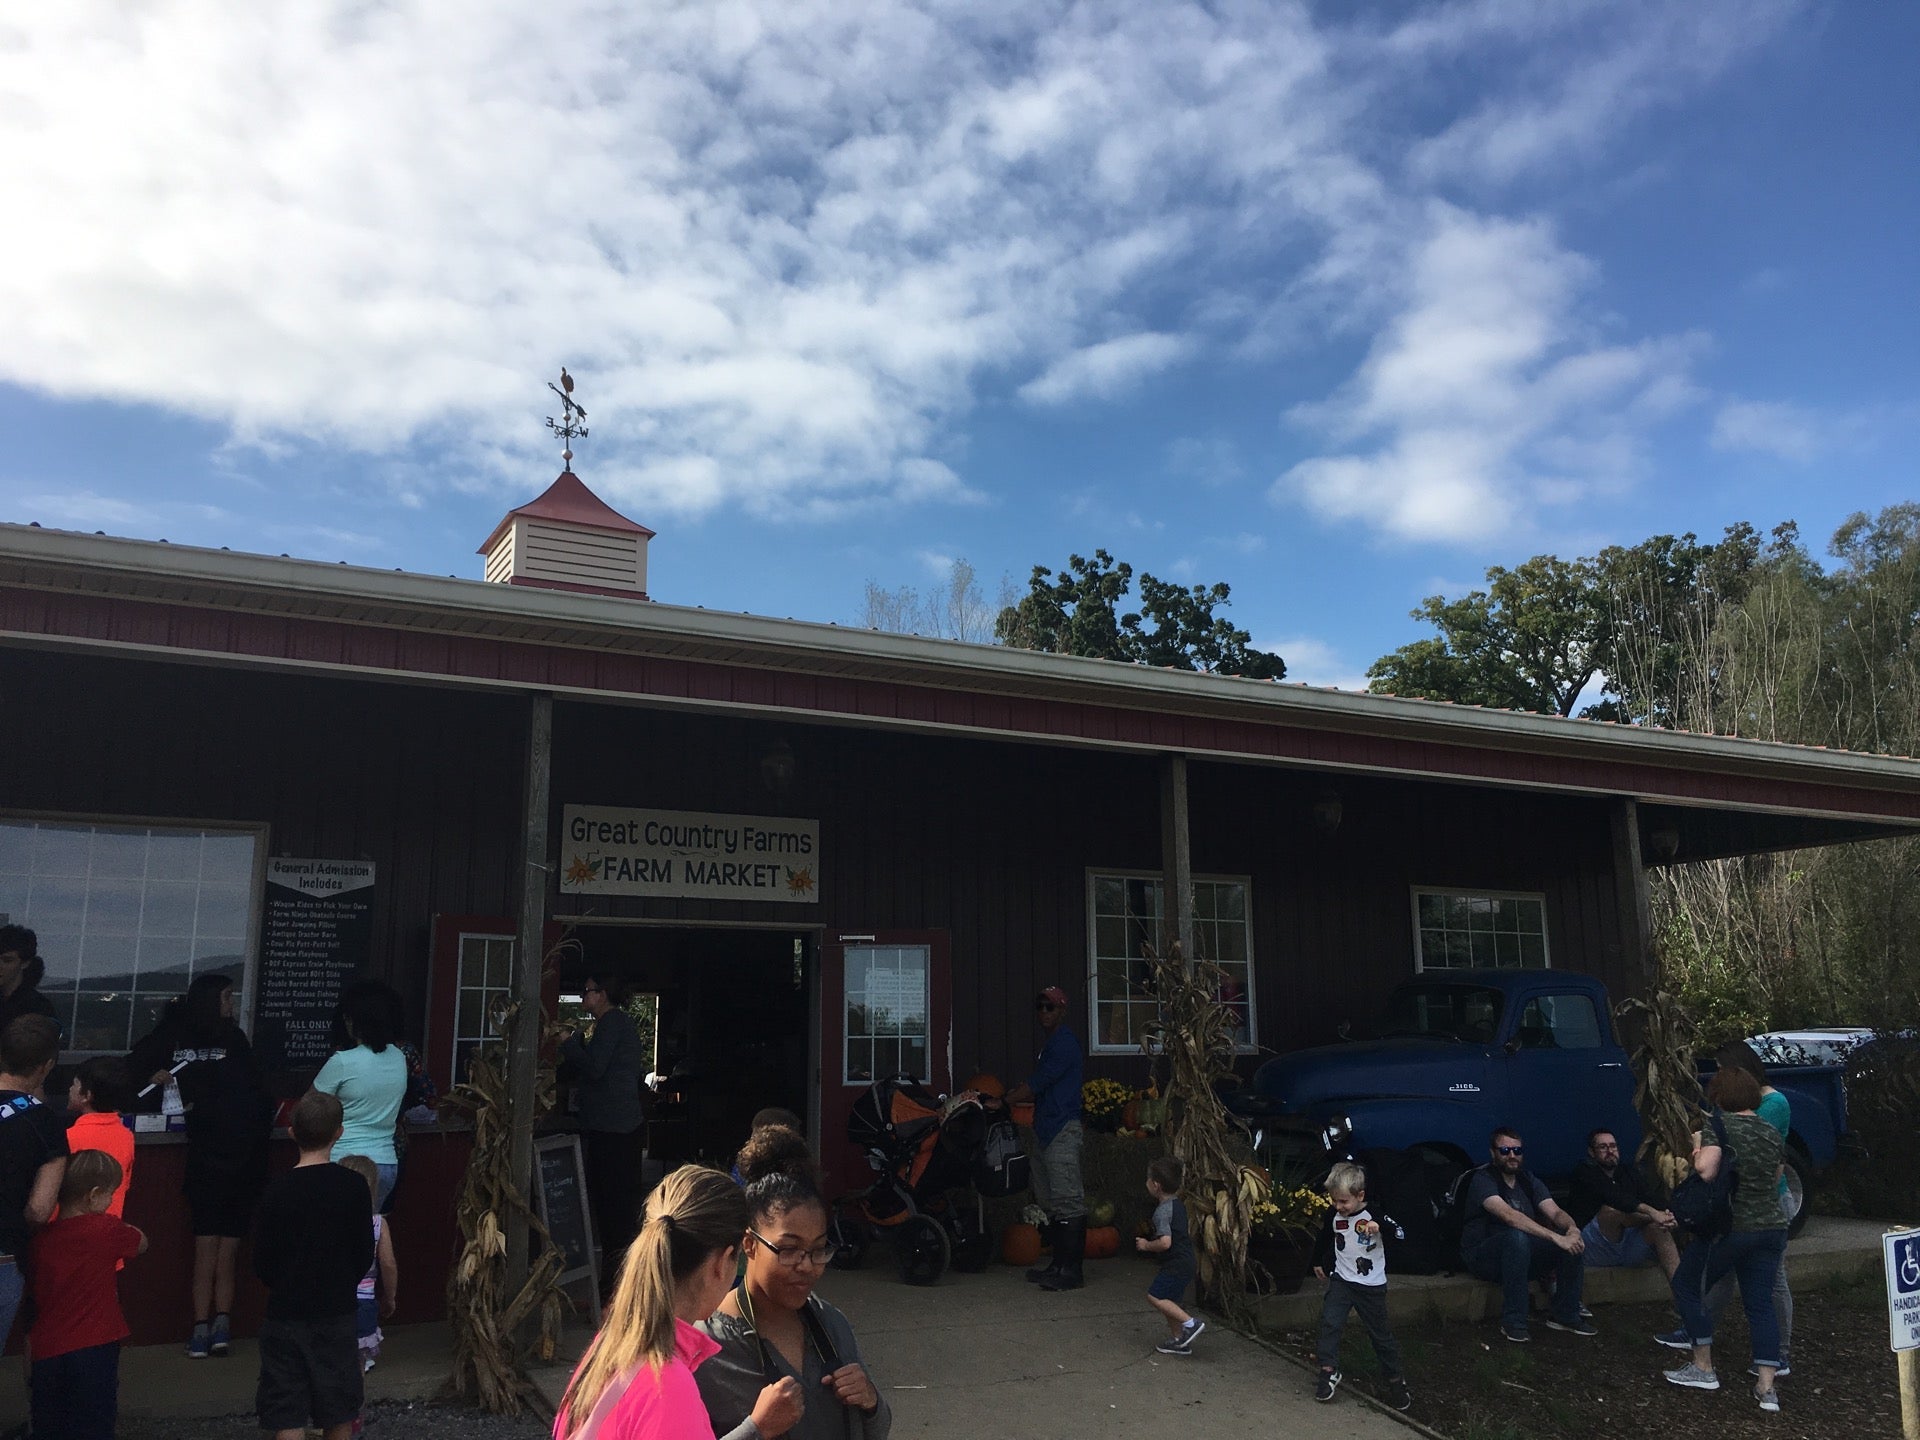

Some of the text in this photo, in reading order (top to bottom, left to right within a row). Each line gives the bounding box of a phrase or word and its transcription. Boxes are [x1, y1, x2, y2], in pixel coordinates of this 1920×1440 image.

[571, 816, 812, 854] Great Country Farms
[274, 861, 369, 876] General Admission
[603, 856, 781, 887] FARM MARKET
[299, 876, 343, 889] Includes
[285, 1020, 333, 1029] FALL ONLY
